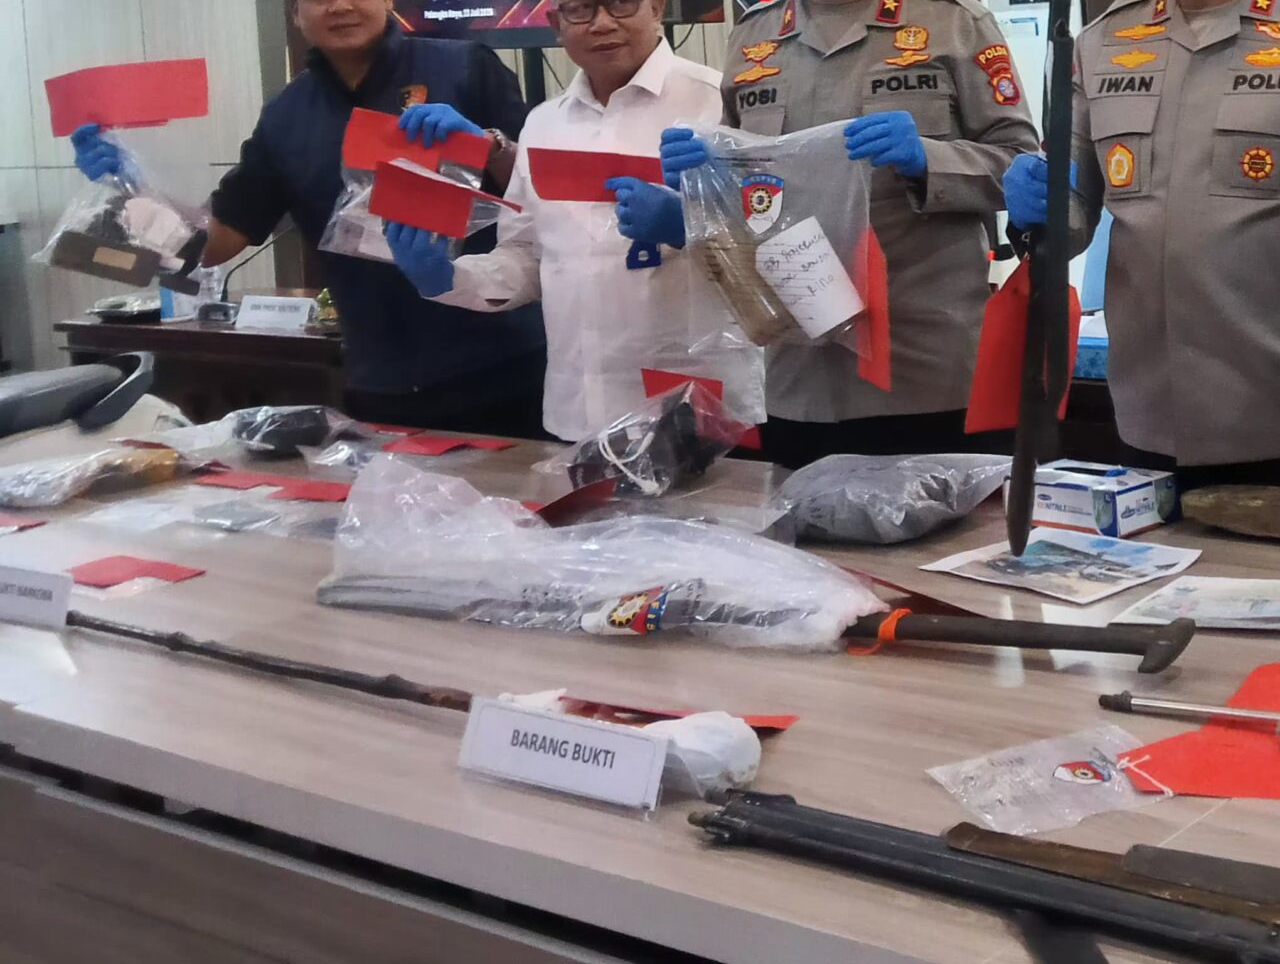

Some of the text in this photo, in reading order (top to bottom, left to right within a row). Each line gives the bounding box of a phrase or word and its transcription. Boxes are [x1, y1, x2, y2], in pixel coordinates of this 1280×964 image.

[871, 74, 938, 95] POLRI
[1098, 75, 1154, 94] IWAN
[738, 87, 777, 110] YOSI
[510, 728, 616, 770] BARANG BUKTI
